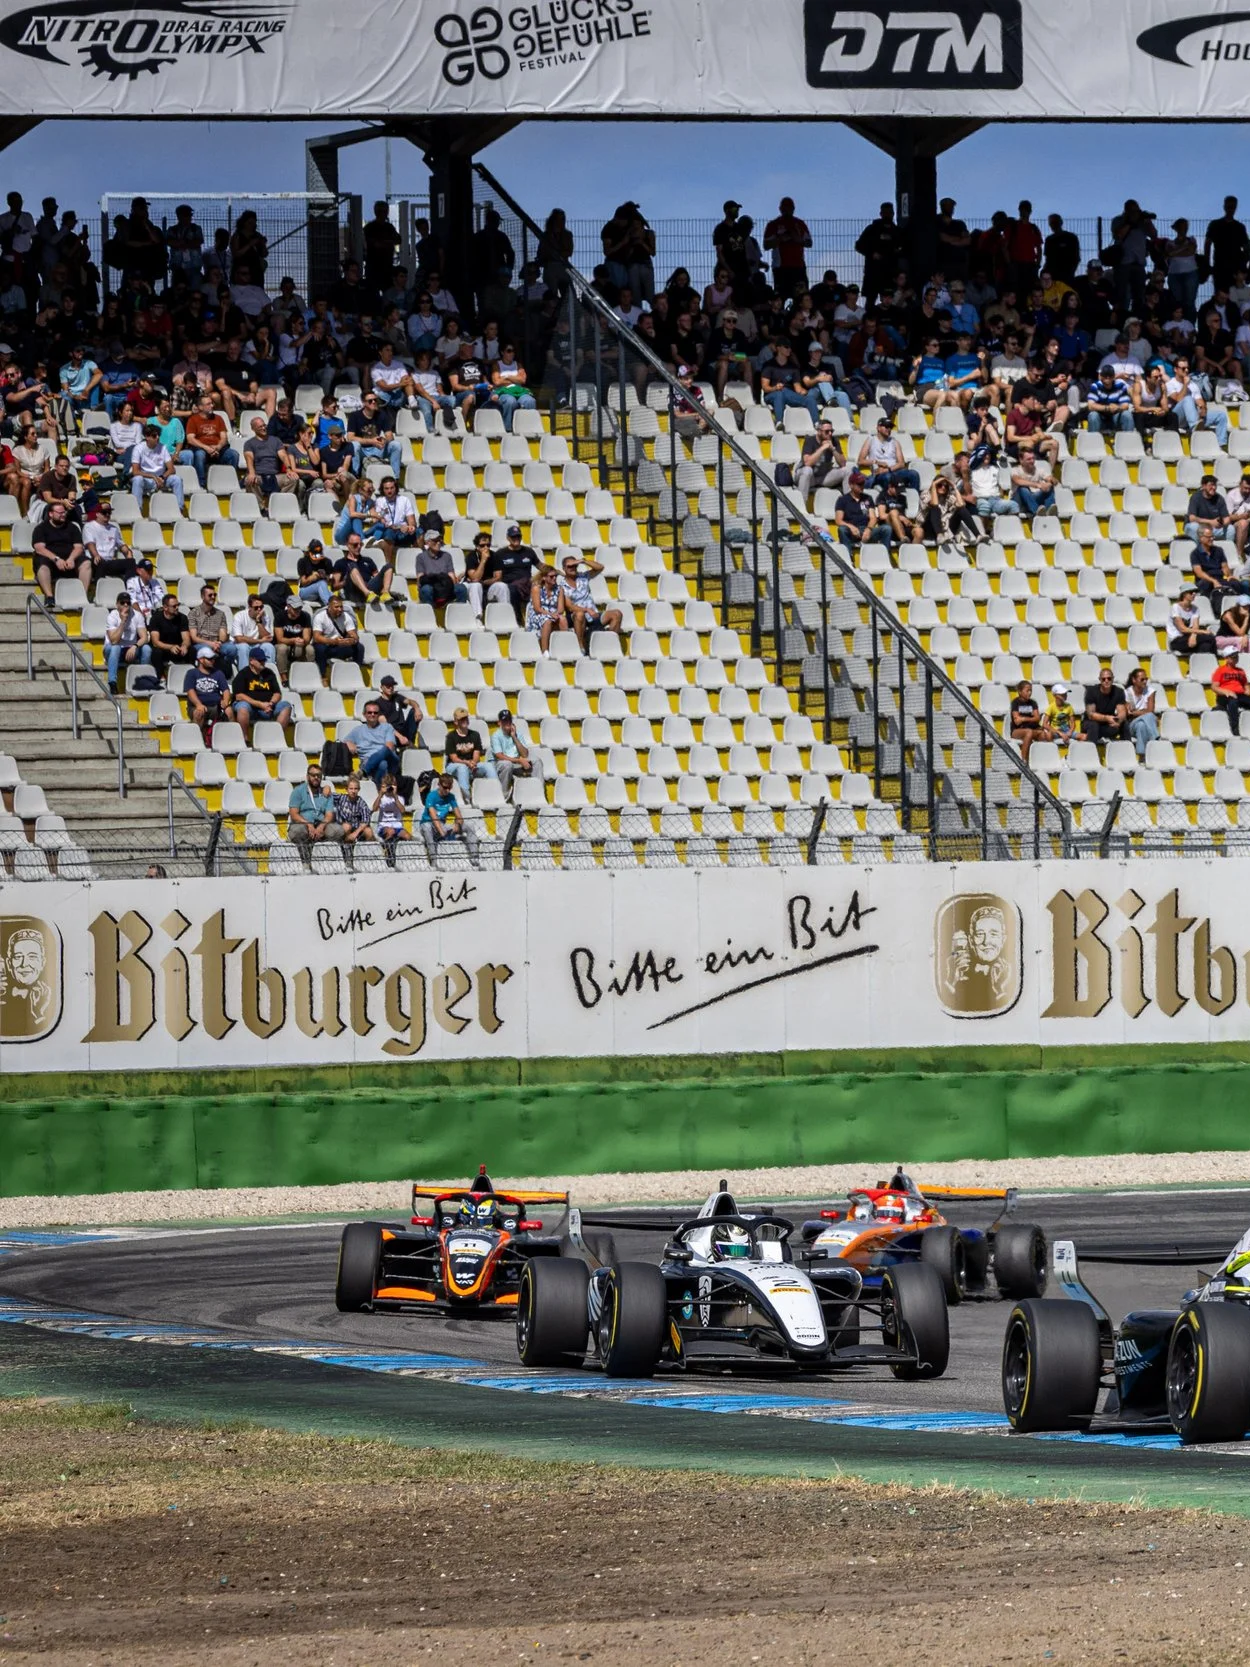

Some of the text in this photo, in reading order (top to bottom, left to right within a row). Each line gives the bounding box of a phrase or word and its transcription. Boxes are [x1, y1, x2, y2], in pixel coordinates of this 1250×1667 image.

[162, 20, 286, 33] DRAG RACING
[820, 11, 1001, 73] DTM
[519, 51, 586, 72] FESTIVAL
[317, 878, 477, 941] Bitte ein Bit
[569, 890, 877, 1009] Bitte ein Bit
[80, 908, 514, 1056] Bitburger
[772, 1279, 801, 1288] 2
